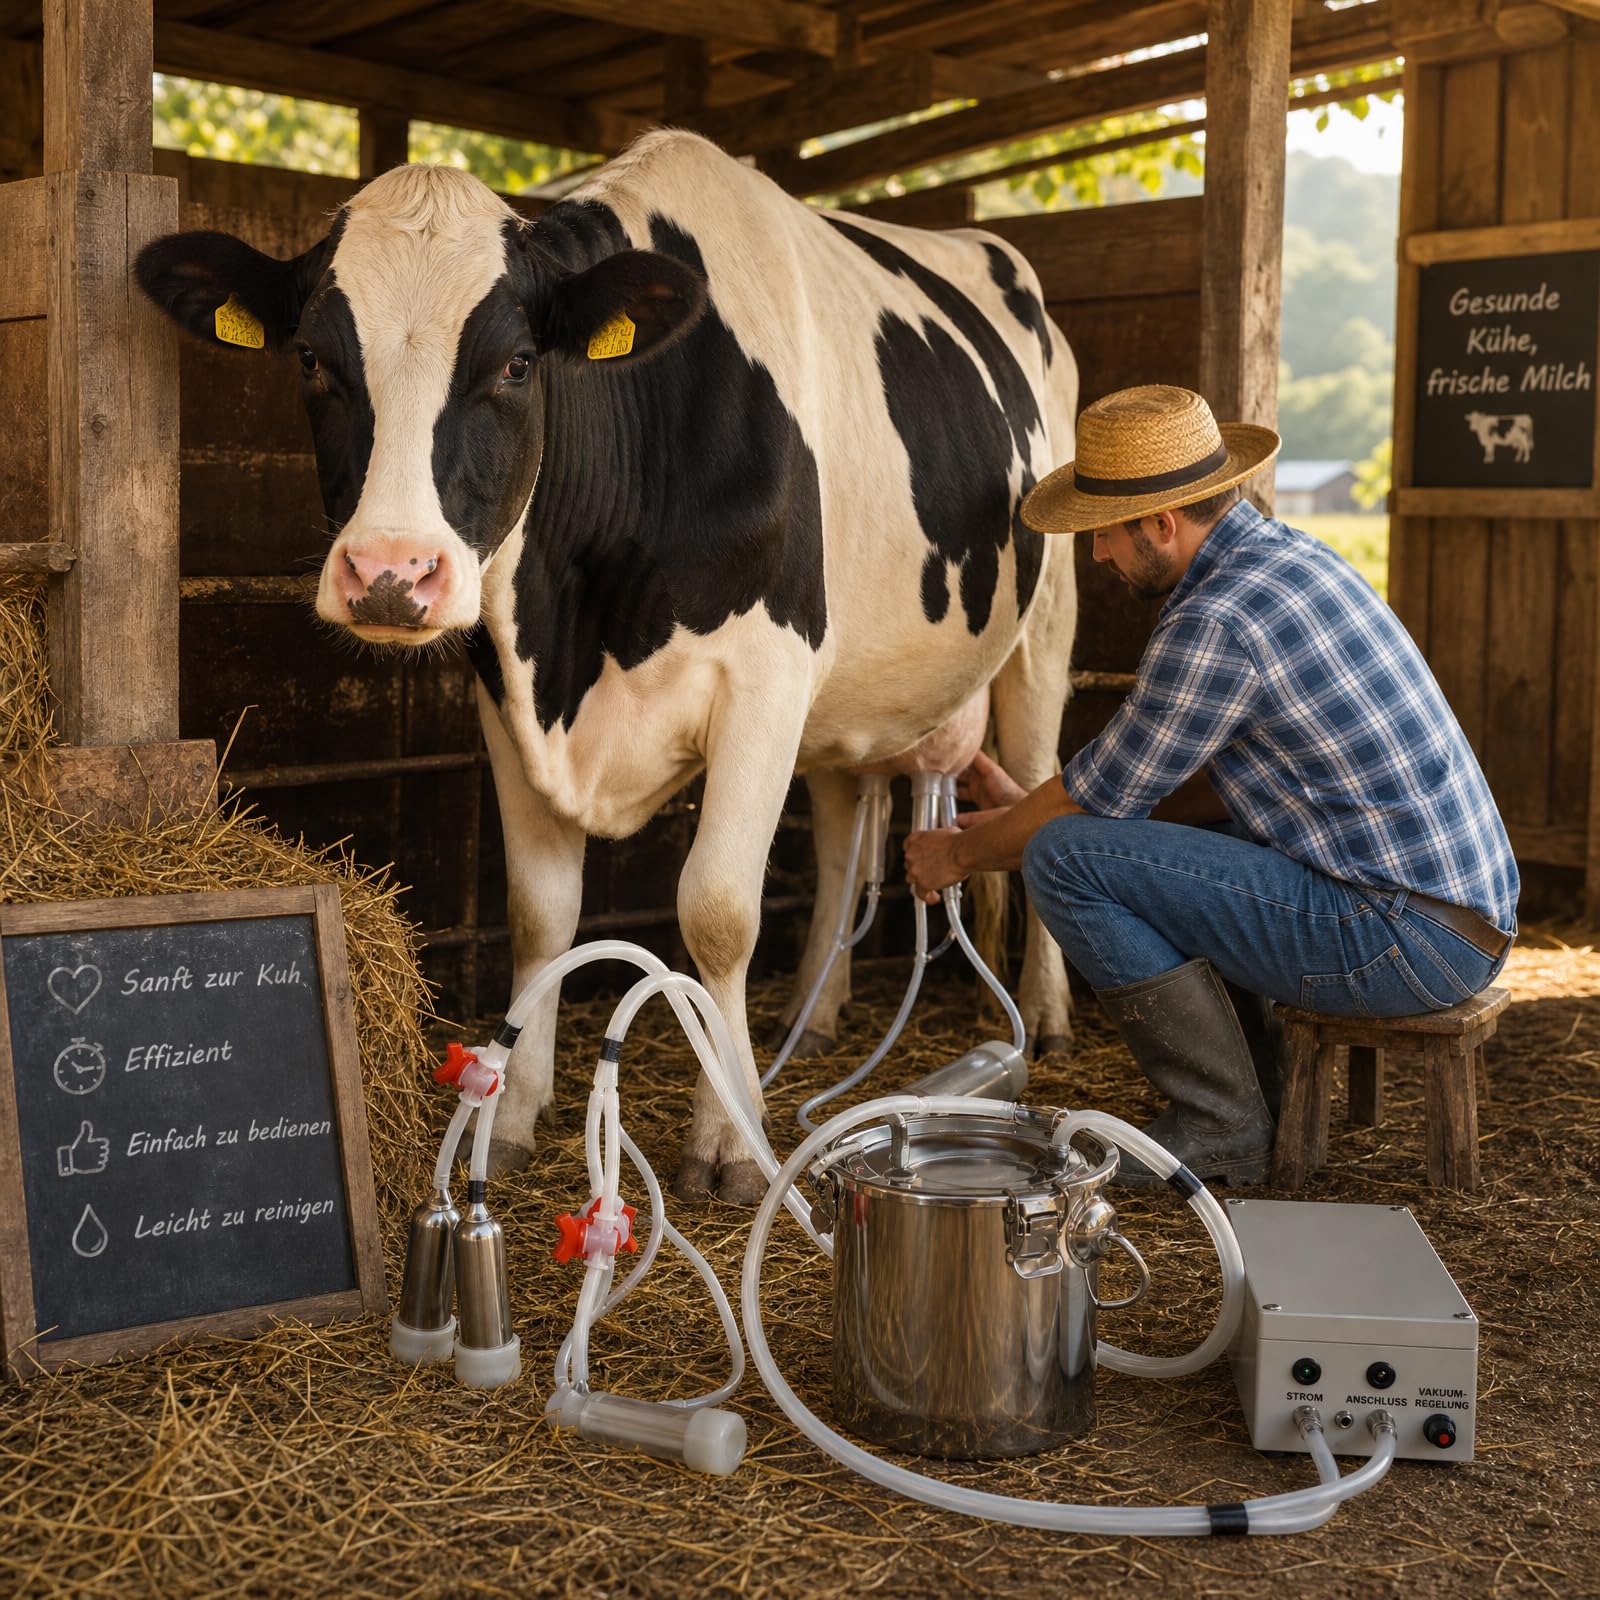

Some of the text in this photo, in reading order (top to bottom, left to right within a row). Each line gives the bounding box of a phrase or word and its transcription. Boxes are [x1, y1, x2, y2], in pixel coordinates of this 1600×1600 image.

[1450, 282, 1560, 316] Gesunde
[1466, 324, 1538, 355] Kühe,
[1427, 361, 1591, 396] frische Milch
[121, 961, 301, 995] Sanft zur Kuh
[124, 1040, 233, 1073] Effizient
[126, 1117, 331, 1157] Einfach zu bedienen
[134, 1197, 334, 1239] Leicht zu reinigen
[1286, 1391, 1324, 1402] STROM
[1345, 1395, 1408, 1407] ANSCHLUSS
[1415, 1399, 1469, 1410] REGELUNG
[1419, 1387, 1468, 1398] VAKUUM-
